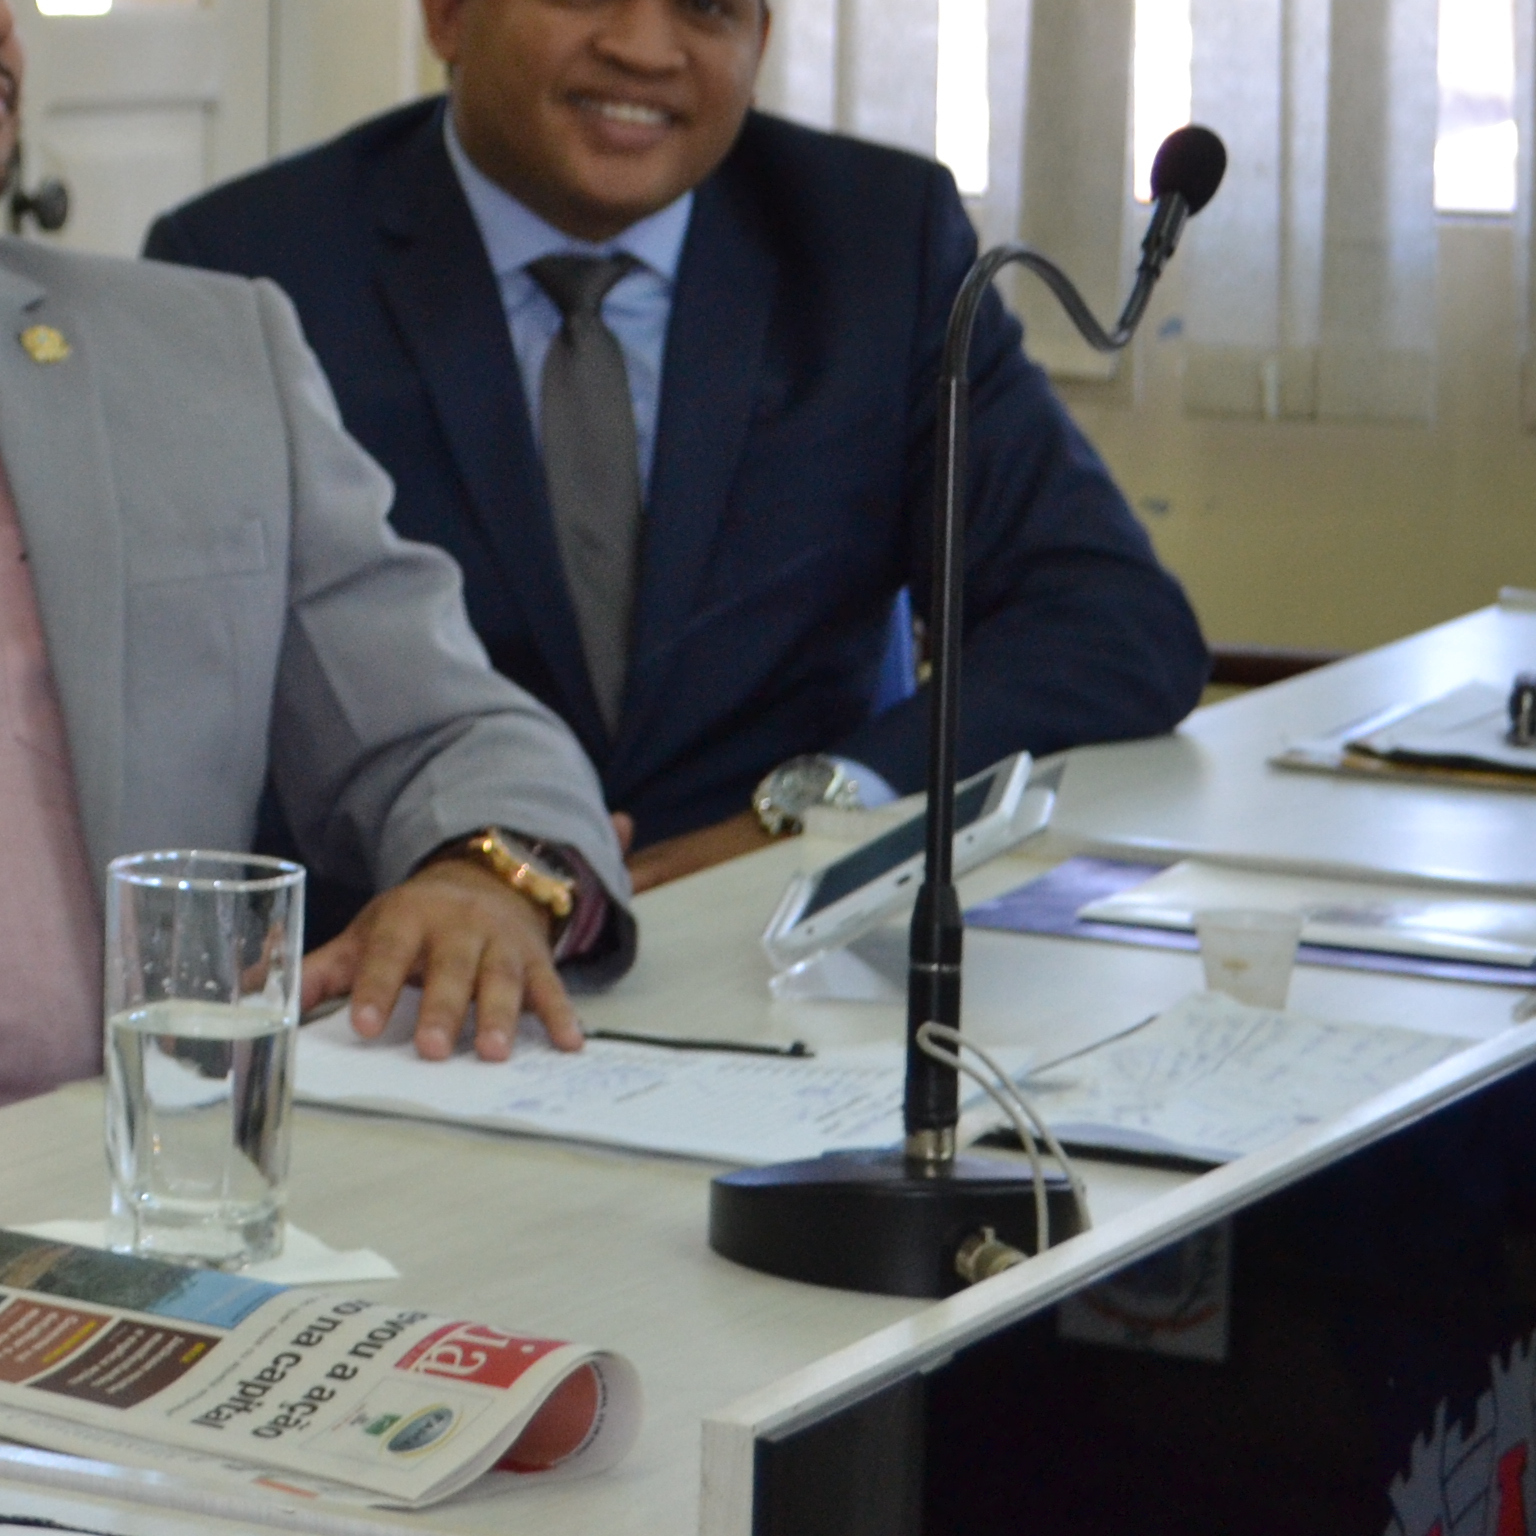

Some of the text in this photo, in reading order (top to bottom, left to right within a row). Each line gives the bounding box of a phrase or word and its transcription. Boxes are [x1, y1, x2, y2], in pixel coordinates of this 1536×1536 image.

[291, 1314, 342, 1349] na
[190, 1351, 302, 1430] capital
[326, 1362, 358, 1381] a
[252, 1384, 336, 1439] ação
